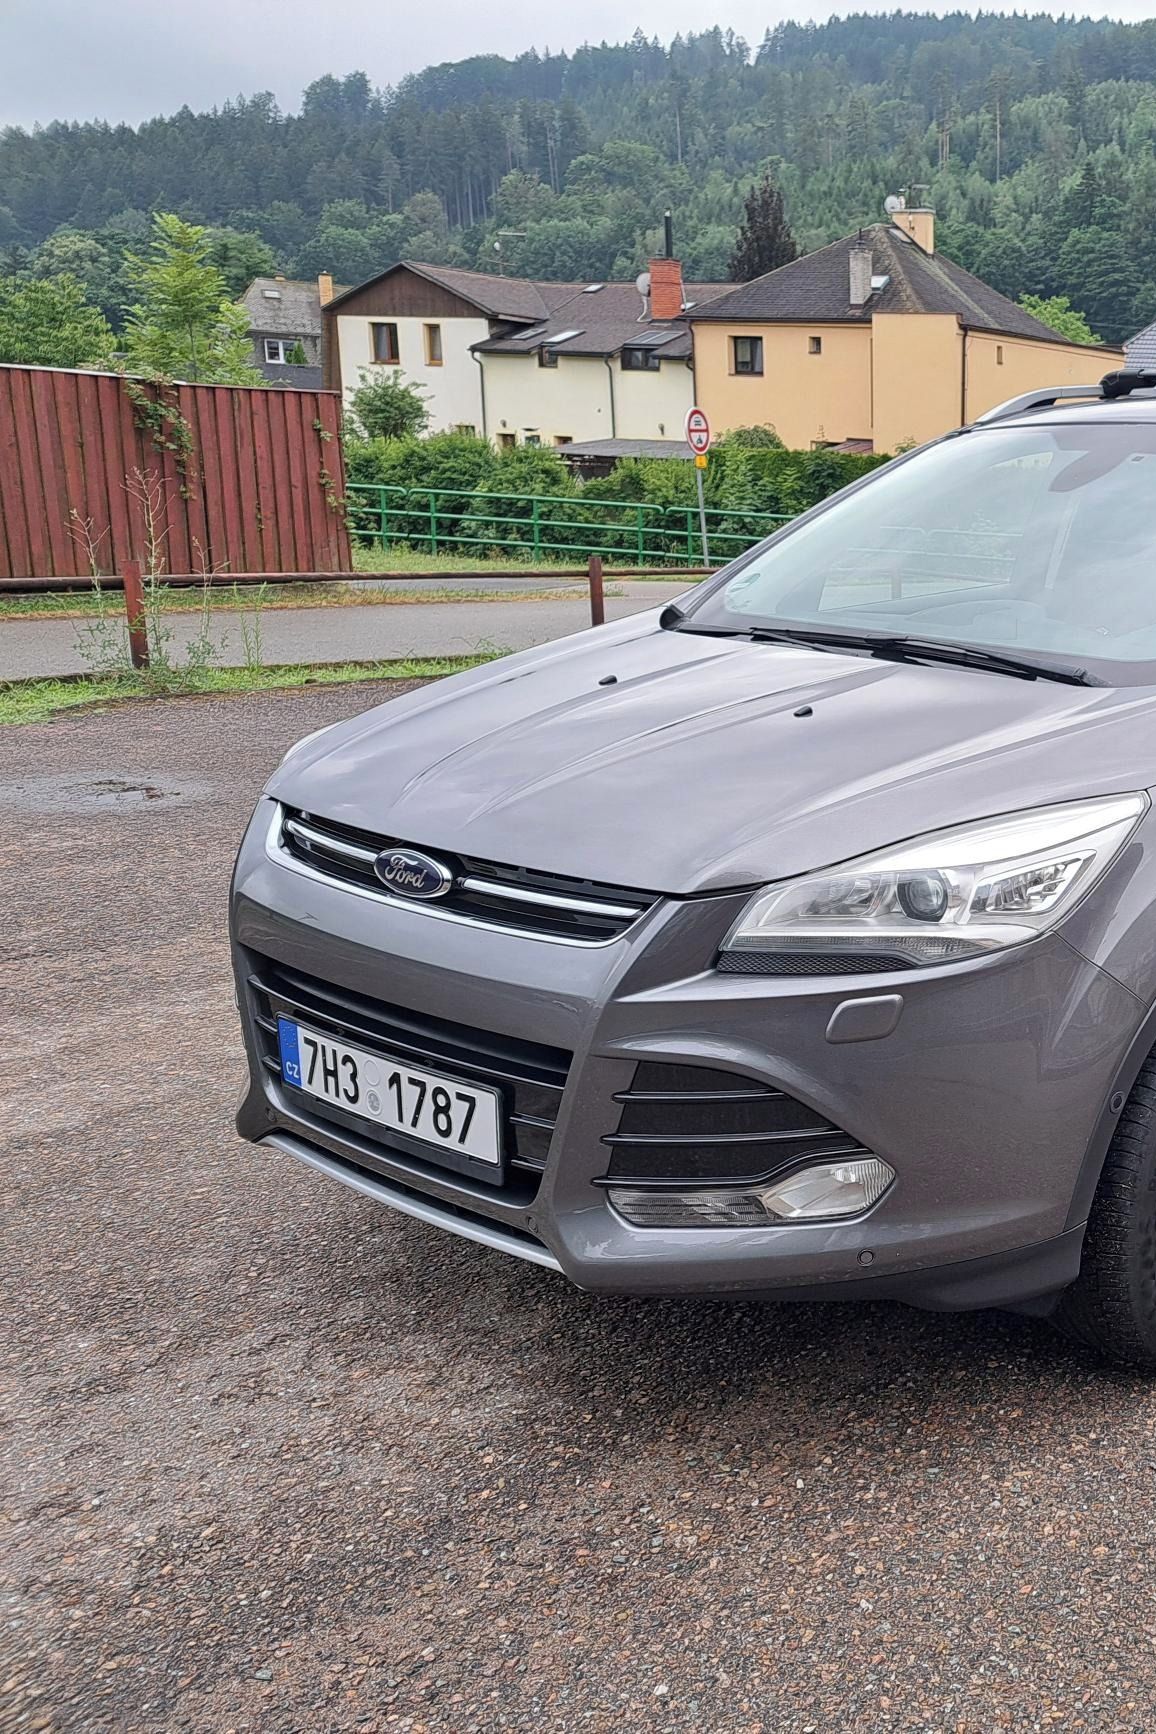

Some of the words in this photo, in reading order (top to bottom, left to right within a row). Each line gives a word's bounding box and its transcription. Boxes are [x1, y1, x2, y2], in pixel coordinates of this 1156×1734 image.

[384, 854, 428, 888] Ford
[285, 1061, 300, 1079] CZ
[303, 1036, 359, 1104] 7H3
[388, 1071, 477, 1145] 1787
